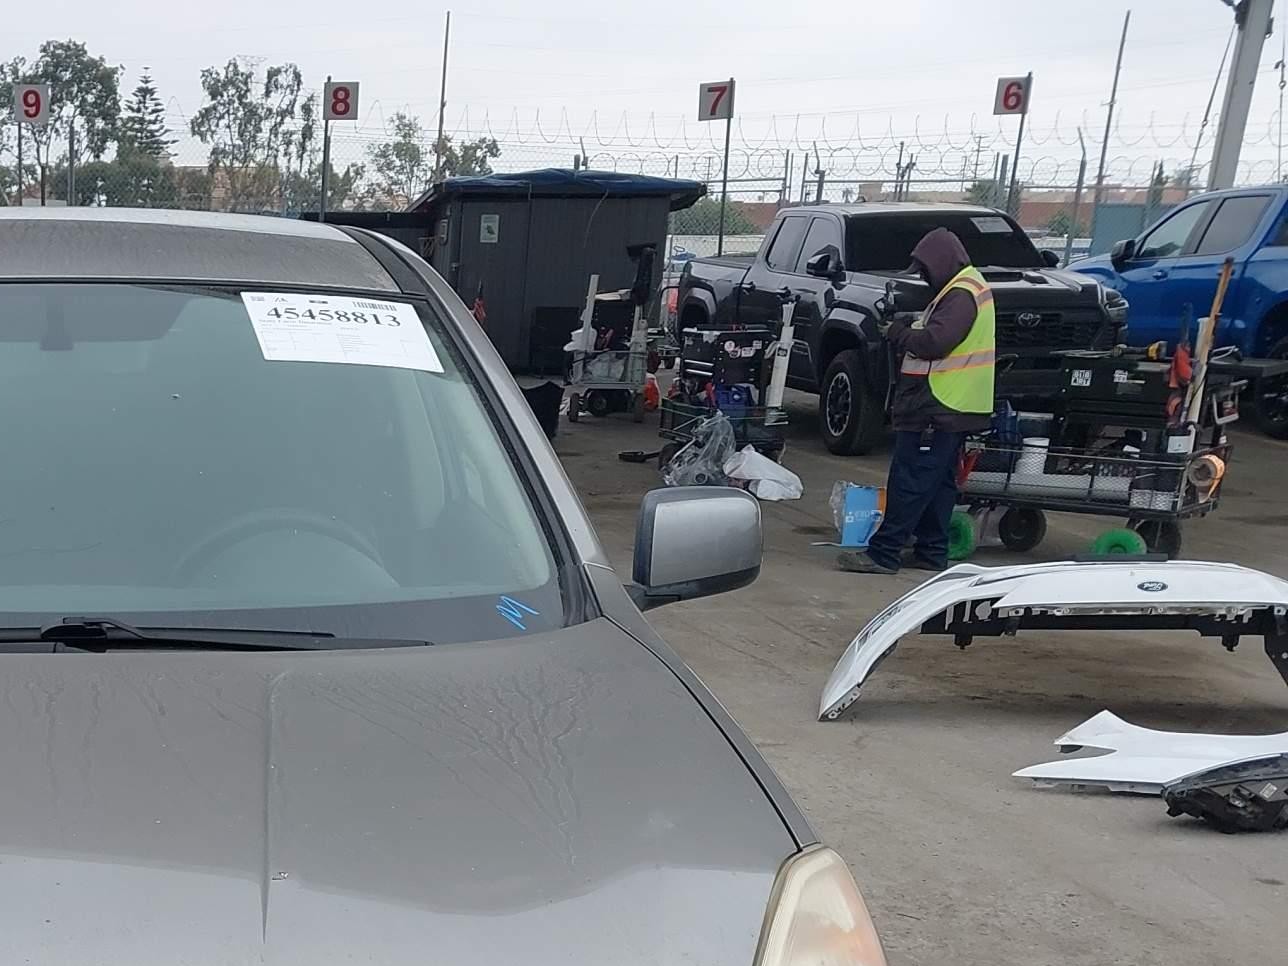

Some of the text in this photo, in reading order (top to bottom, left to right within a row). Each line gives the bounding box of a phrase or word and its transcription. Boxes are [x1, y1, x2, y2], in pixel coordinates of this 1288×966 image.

[23, 89, 40, 118] 9
[332, 86, 350, 115] 8
[707, 86, 727, 116] 7
[1003, 81, 1022, 110] 6
[267, 307, 401, 327] 45458813
